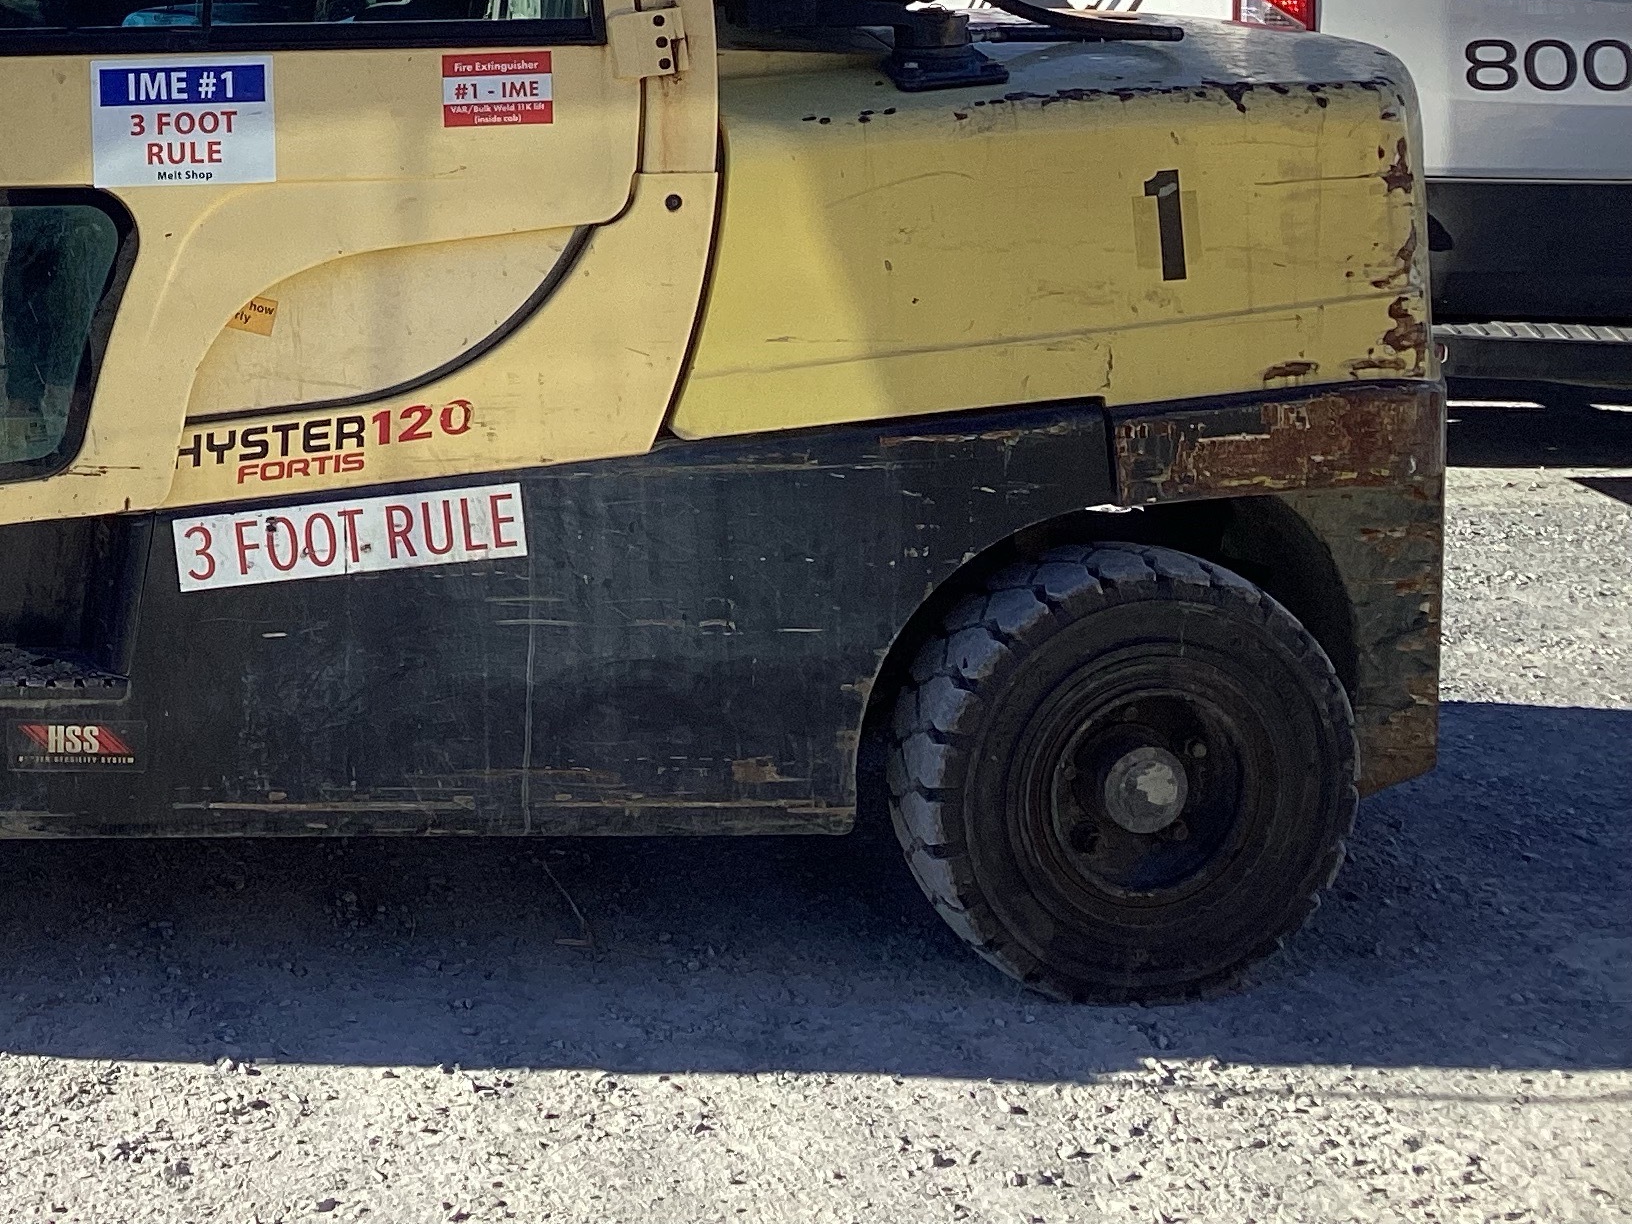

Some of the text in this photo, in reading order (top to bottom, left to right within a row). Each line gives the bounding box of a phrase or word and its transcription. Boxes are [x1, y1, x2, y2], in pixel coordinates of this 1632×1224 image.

[454, 59, 539, 72] Fire Extinguisher
[1464, 38, 1632, 92] 800
[128, 71, 234, 101] IME #1
[454, 83, 478, 100] #1
[501, 80, 539, 98] IME
[130, 110, 238, 136] 3 FOOT
[450, 104, 492, 115] VAR/Bulk
[494, 103, 515, 112] Weld
[474, 114, 522, 124] (inside cab)
[147, 140, 222, 165] RULE
[157, 169, 213, 182] Melt Shop
[1144, 169, 1187, 281] 1
[176, 399, 473, 469] HYSTER 120
[236, 451, 366, 484] FORTIS
[184, 493, 518, 581] 3 FOOT RULE
[48, 724, 100, 754] HSS
